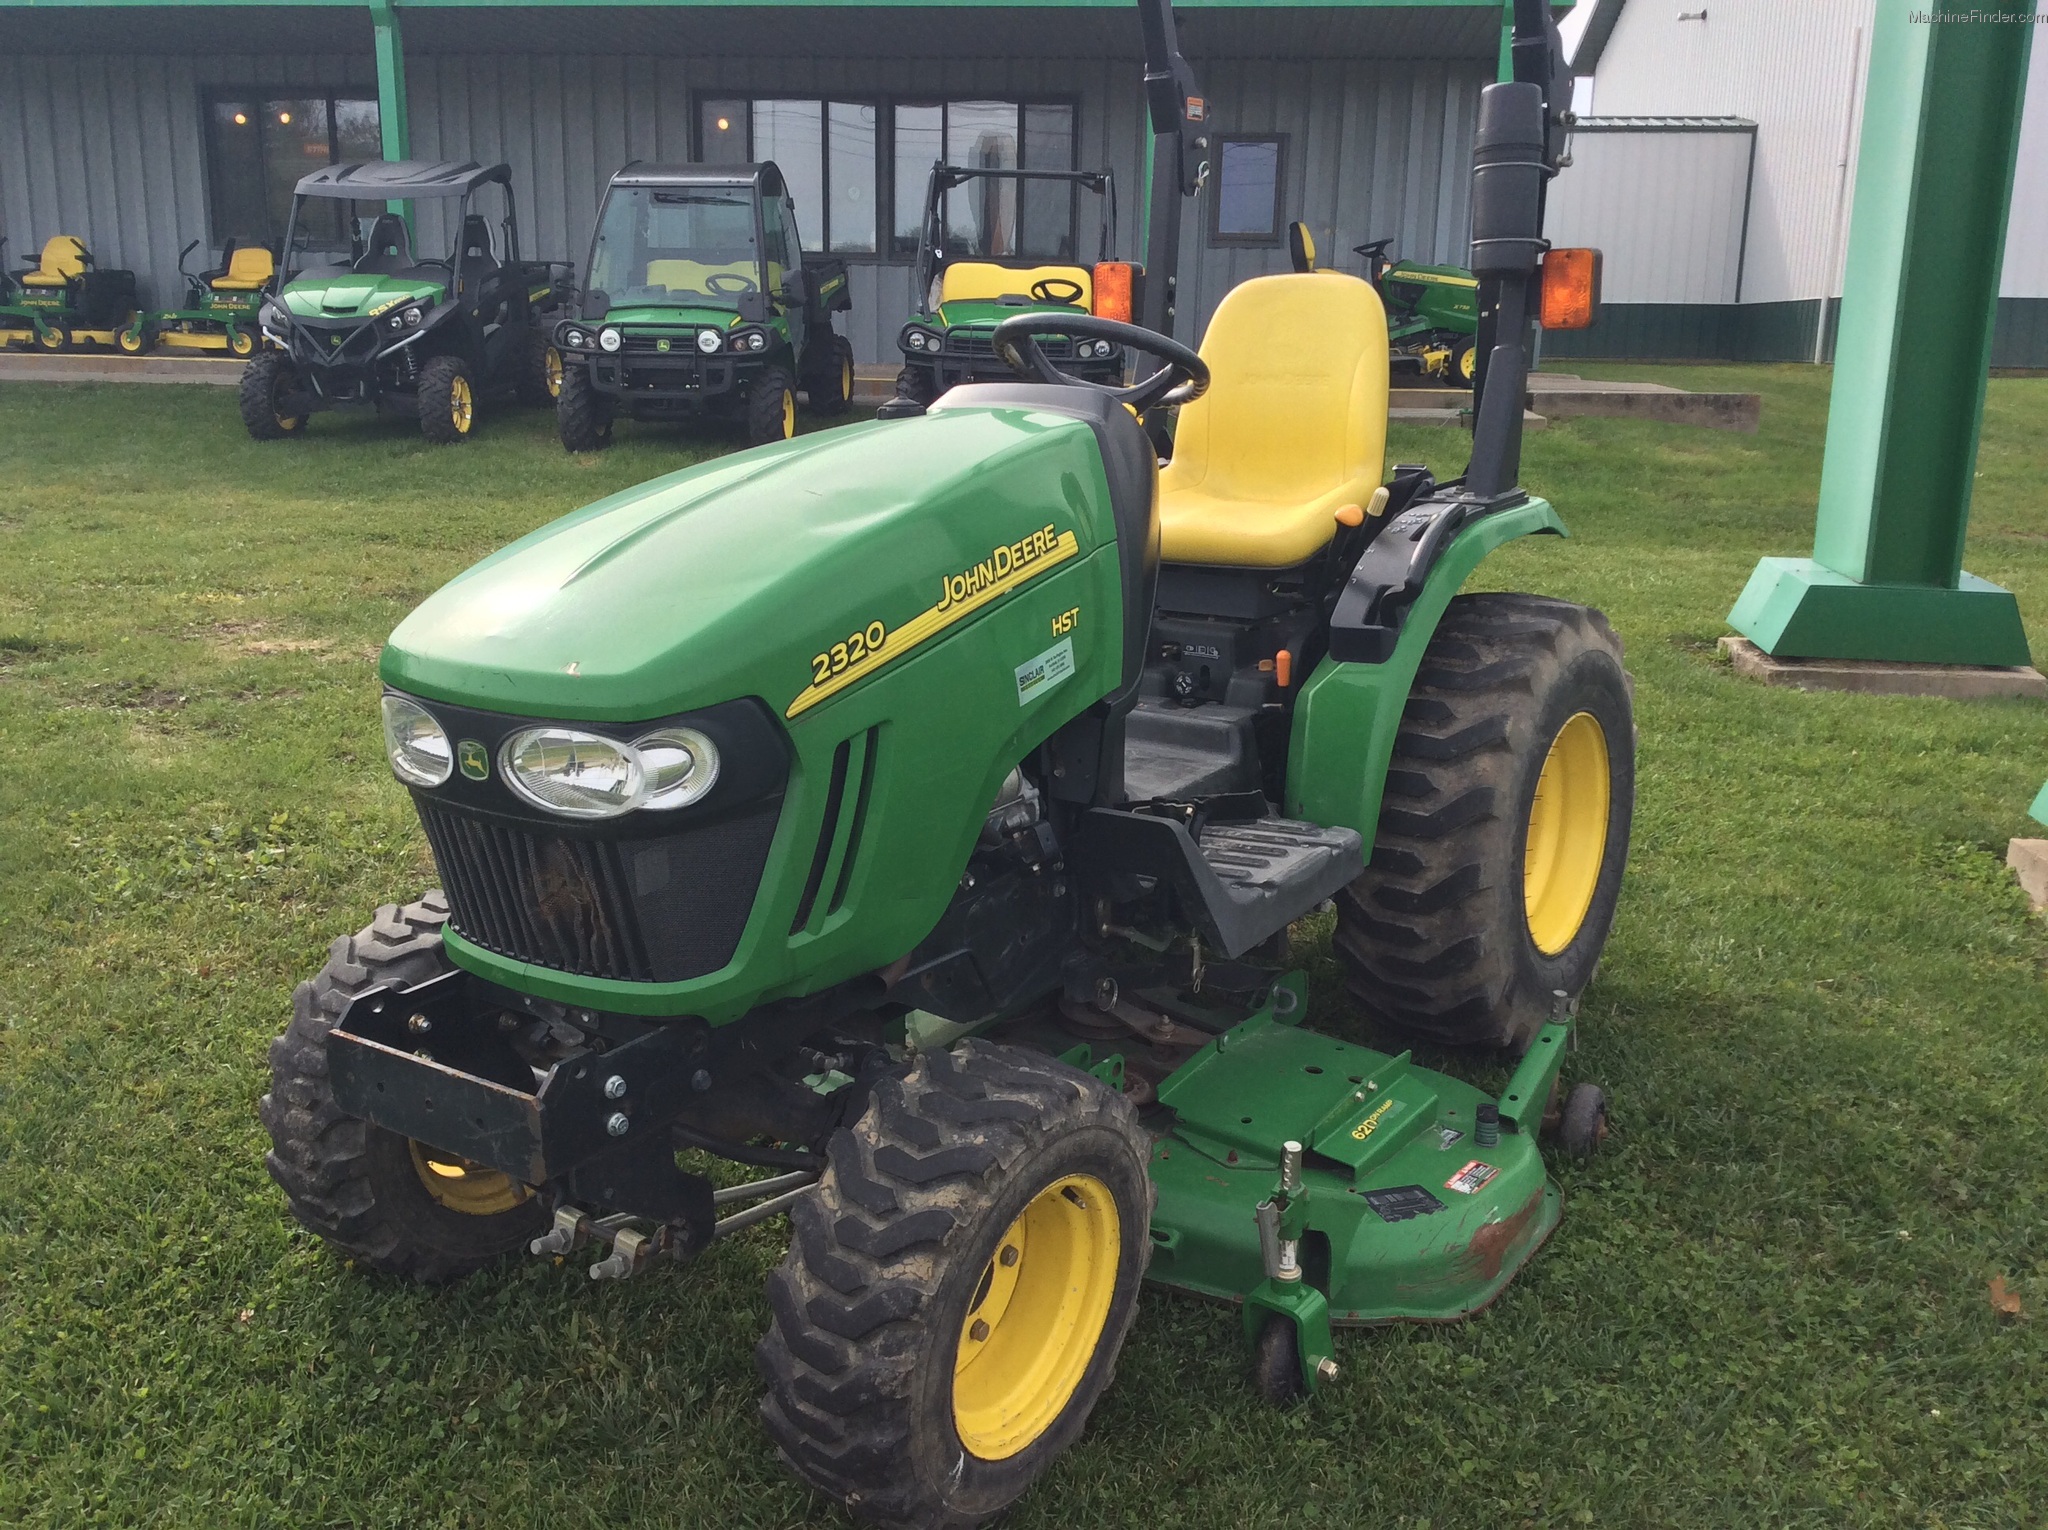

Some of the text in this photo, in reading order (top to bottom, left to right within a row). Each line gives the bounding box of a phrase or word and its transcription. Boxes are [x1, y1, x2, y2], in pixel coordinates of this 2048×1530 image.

[38, 299, 60, 307] DEERE
[938, 523, 1057, 611] JOHN DEERE
[1051, 607, 1080, 637] HST
[812, 621, 885, 685] 2320
[1019, 665, 1045, 686] SINCLAIR
[1351, 1119, 1378, 1140] 62D
